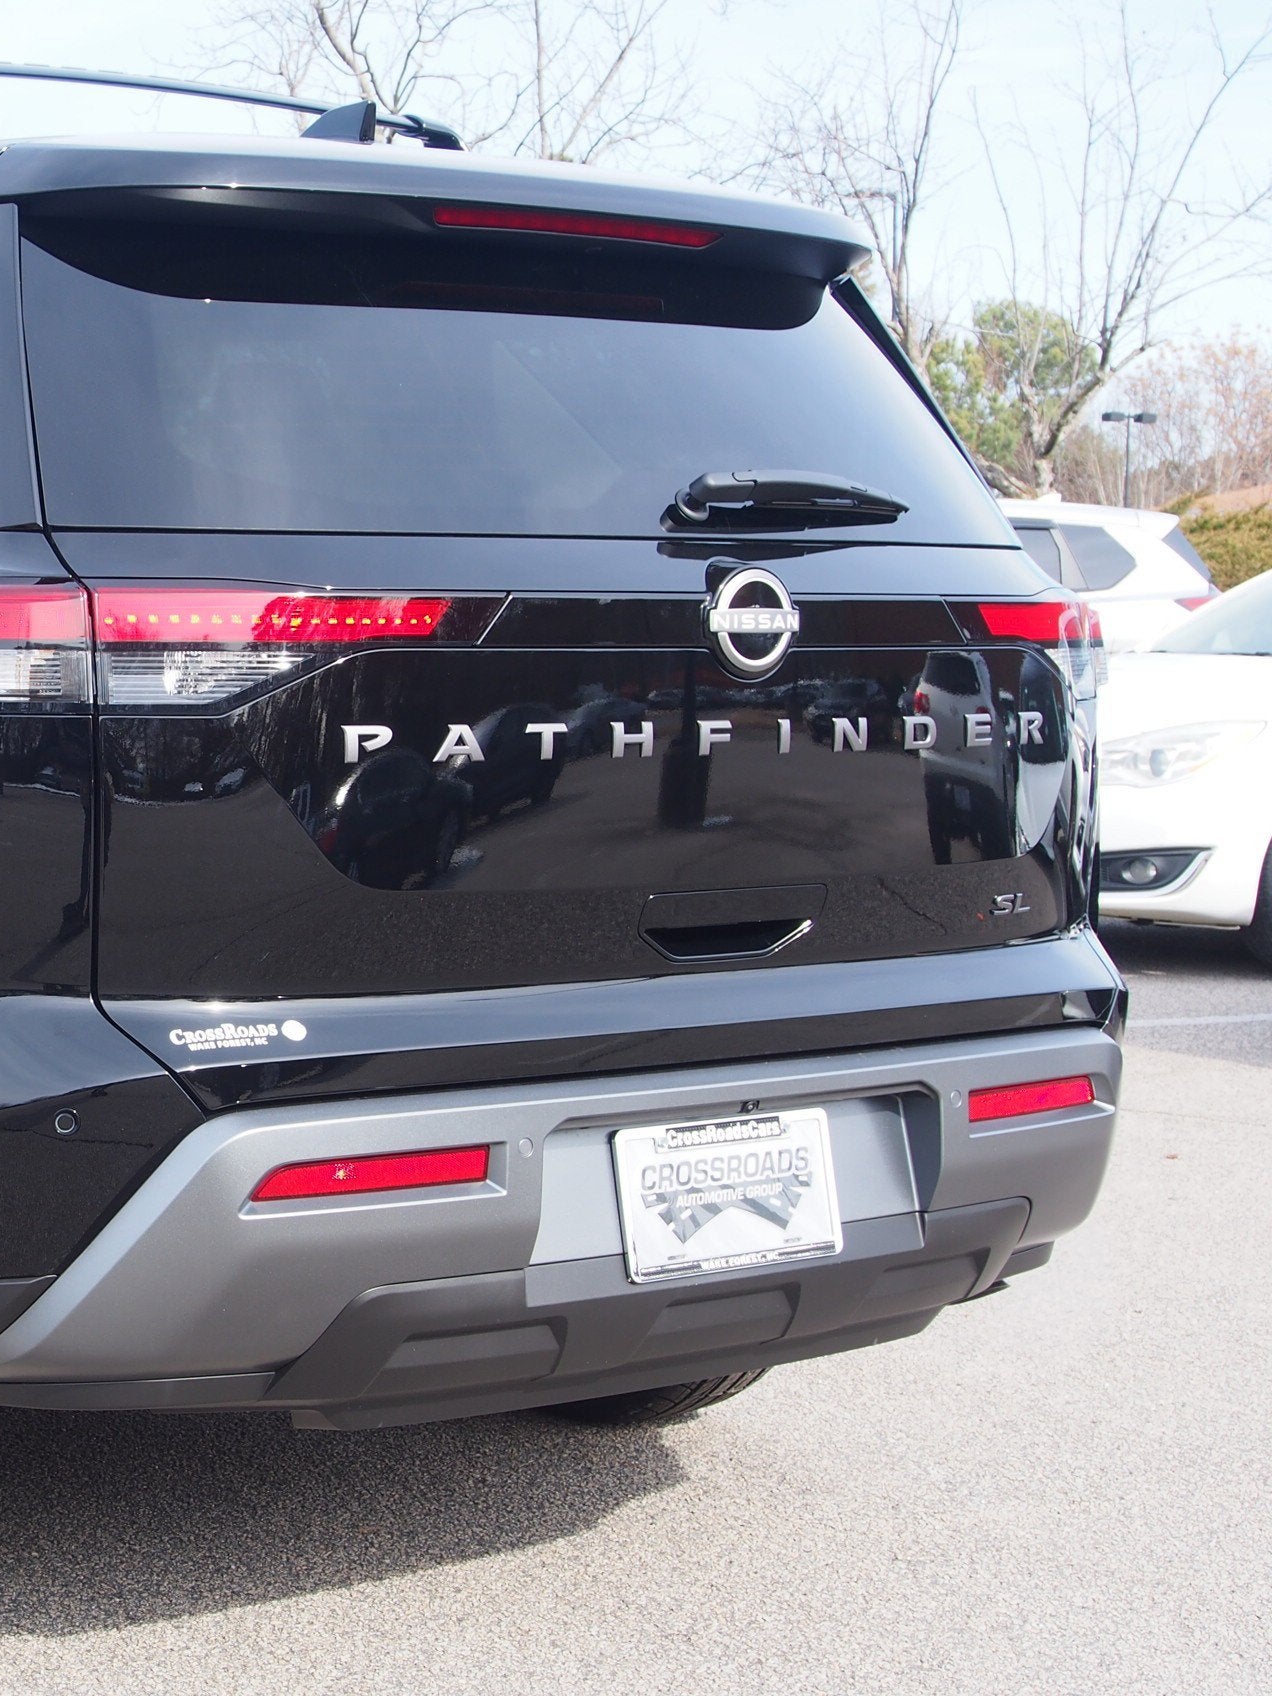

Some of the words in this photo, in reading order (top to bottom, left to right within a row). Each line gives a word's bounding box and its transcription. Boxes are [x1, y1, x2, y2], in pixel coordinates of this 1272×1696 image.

[710, 607, 799, 633] NISSAN
[341, 710, 1046, 765] PATHFINDER
[988, 891, 1031, 917] SL
[188, 1041, 216, 1051] WAKE
[255, 1037, 268, 1045] NC
[640, 1146, 810, 1192] CROSSROADS
[676, 1187, 745, 1208] AUTOMOTIVE
[746, 1182, 784, 1199] GROUP
